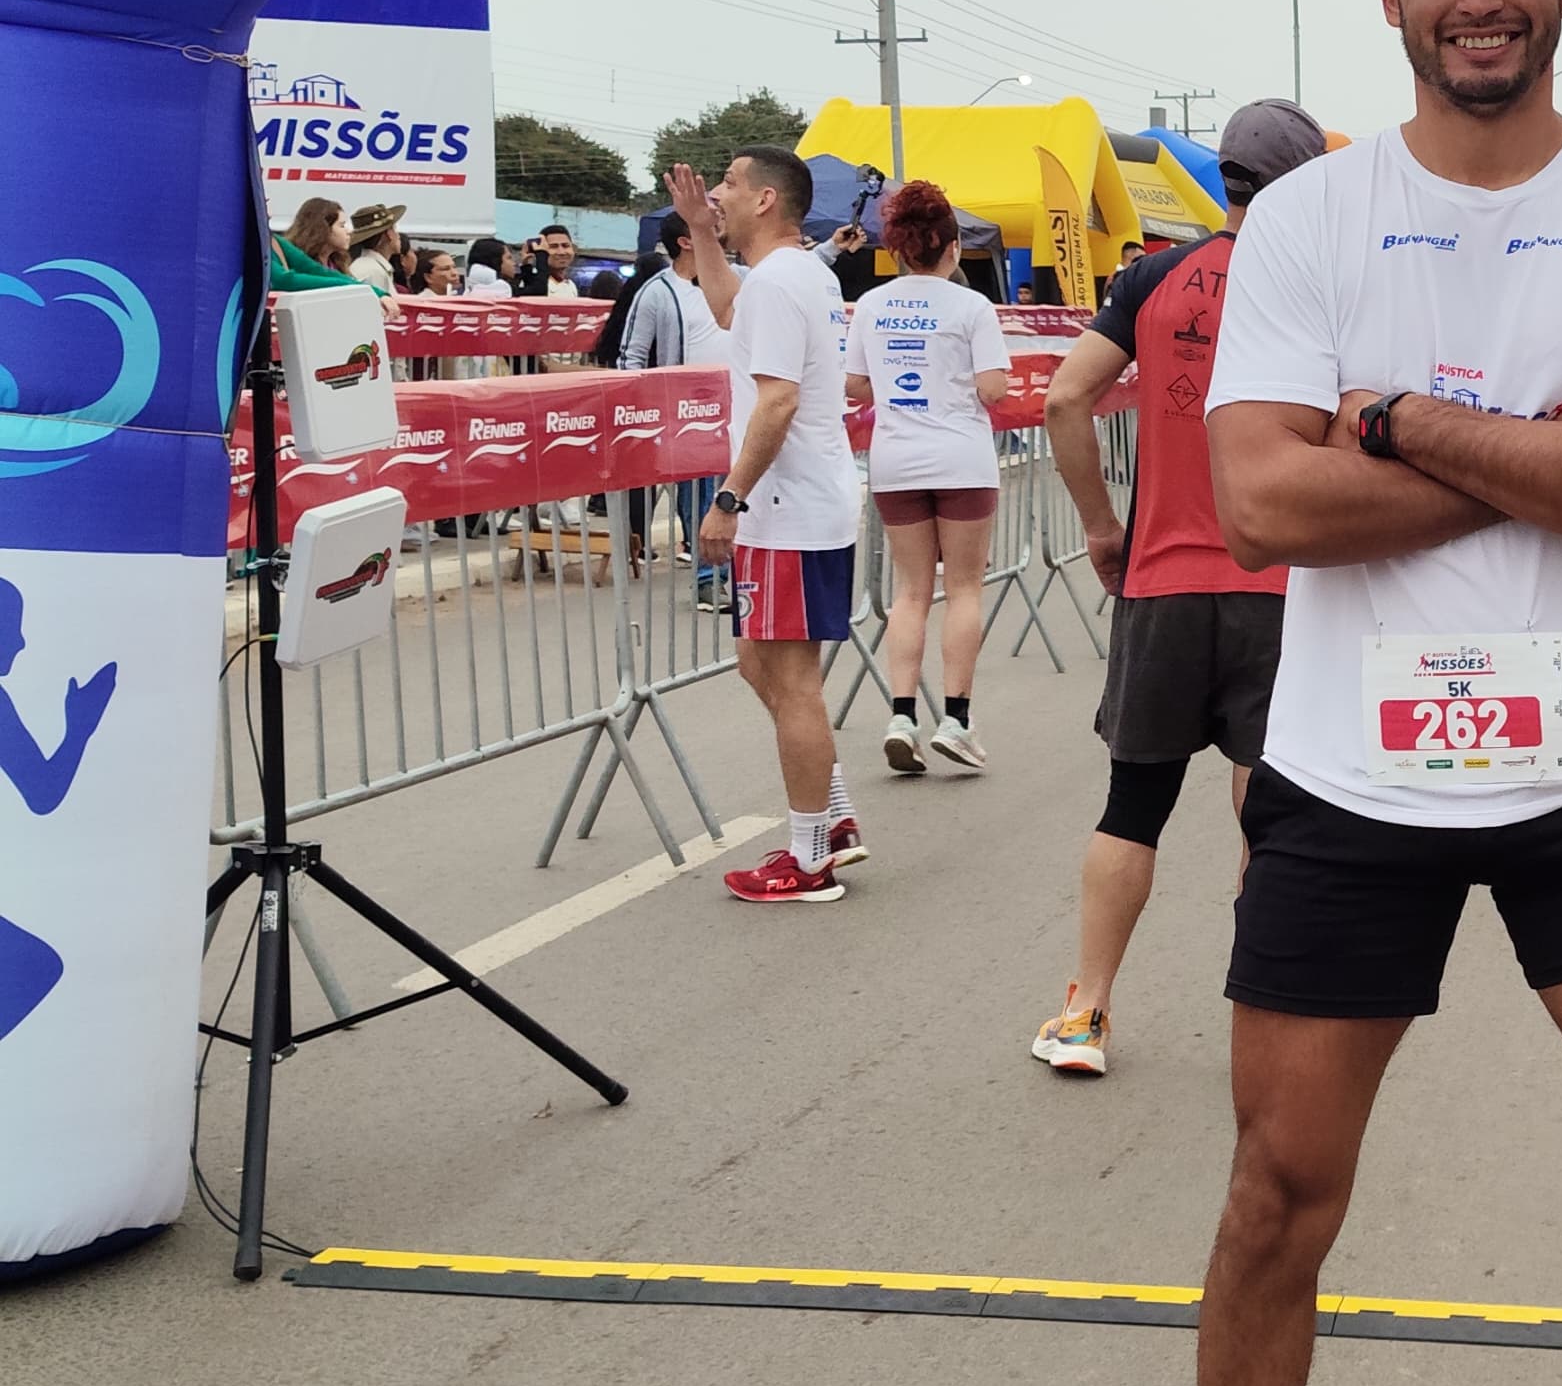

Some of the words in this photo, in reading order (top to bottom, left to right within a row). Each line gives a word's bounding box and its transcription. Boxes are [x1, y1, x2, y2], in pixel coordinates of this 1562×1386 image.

[886, 299, 929, 309] ATLETA
[875, 315, 938, 330] MISSÕES
[382, 429, 445, 450] ENNER
[468, 418, 526, 441] RENNER
[546, 411, 596, 433] RENNER
[613, 405, 660, 426] RENNER
[677, 400, 721, 419] RENNER
[1424, 656, 1485, 671] MISSÕES
[1448, 681, 1473, 697] 5K
[1413, 699, 1511, 750] 262
[766, 876, 798, 892] FILA
